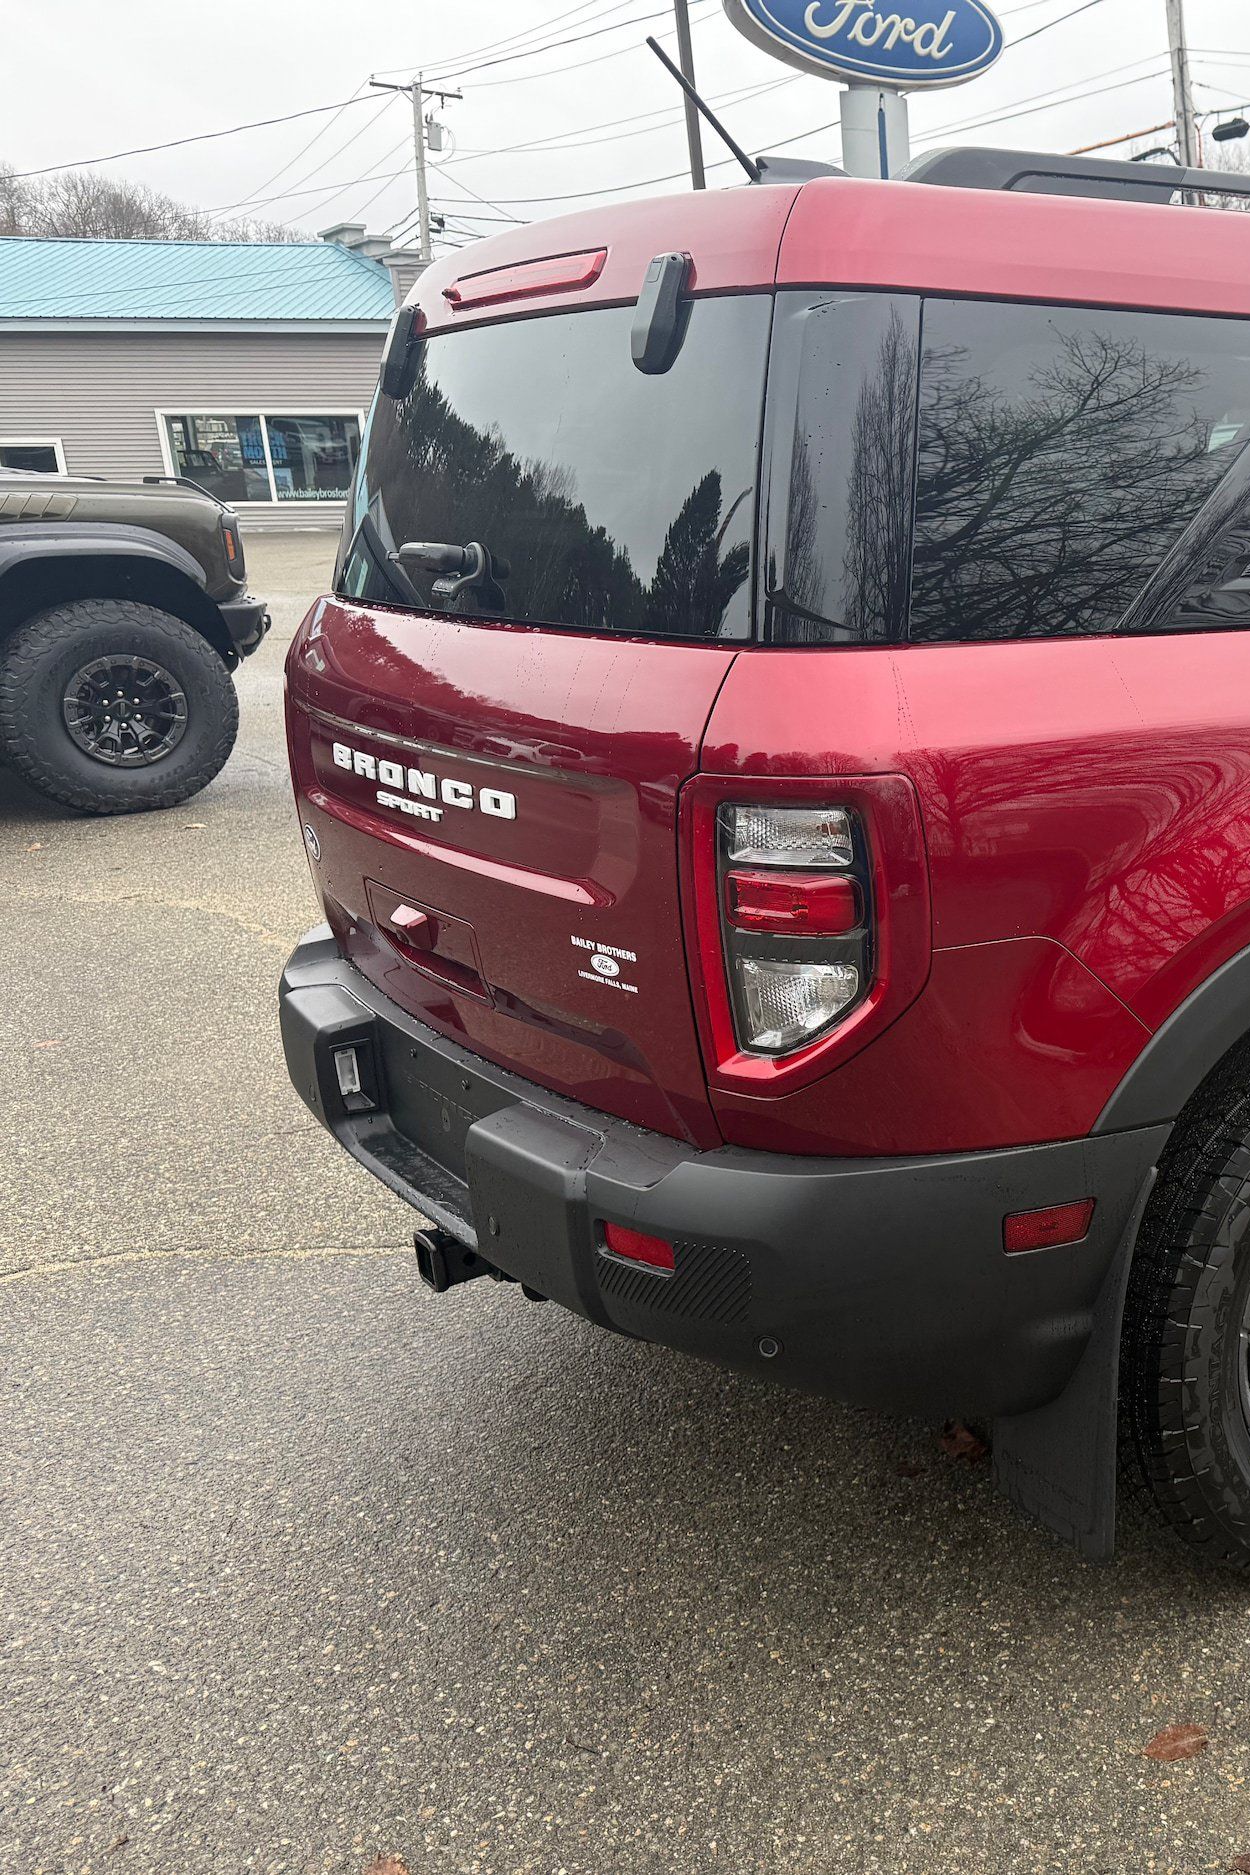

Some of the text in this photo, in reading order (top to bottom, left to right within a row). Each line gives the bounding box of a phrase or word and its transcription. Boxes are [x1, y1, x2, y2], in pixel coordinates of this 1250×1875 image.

[804, 0, 957, 60] Ford
[243, 445, 288, 459] MOTH
[333, 742, 517, 820] BRONCO
[376, 790, 444, 822] SPORT
[570, 935, 637, 963] BAILEY BROTHERS
[596, 958, 613, 972] Ford
[577, 969, 639, 994] LIVERMORE FALLS, MAINE
